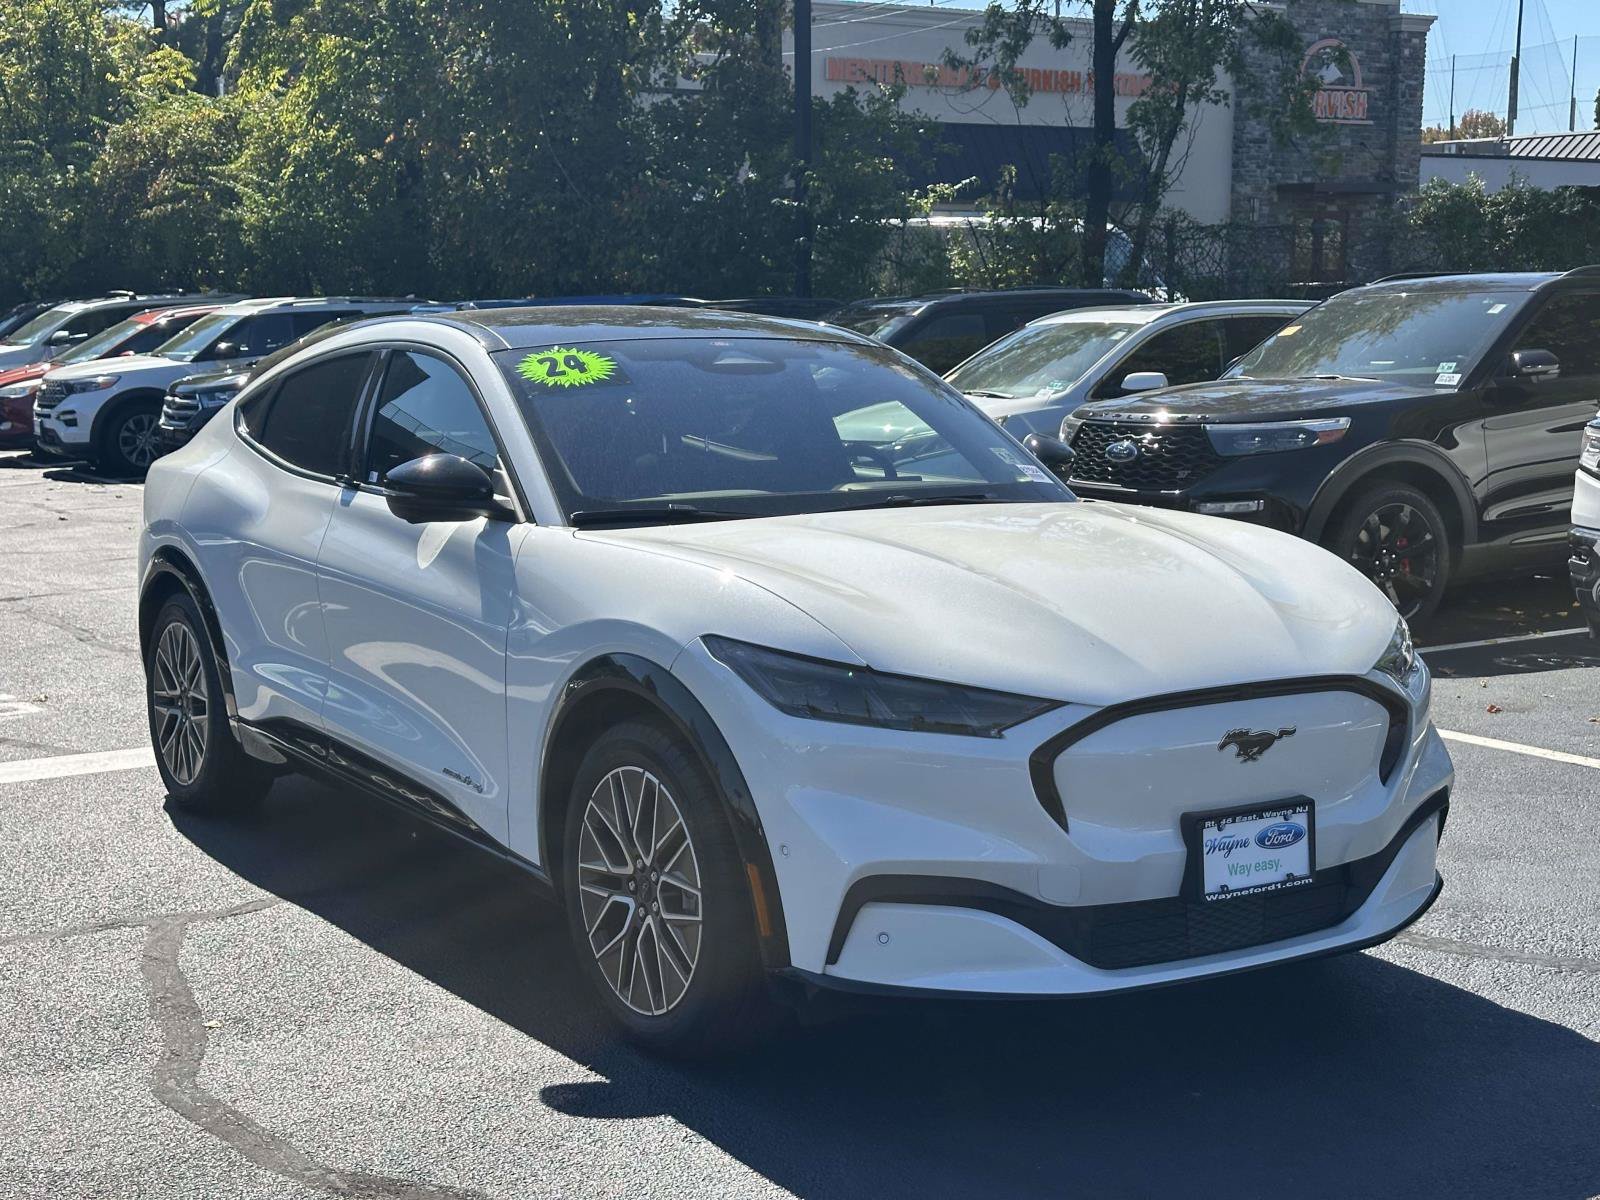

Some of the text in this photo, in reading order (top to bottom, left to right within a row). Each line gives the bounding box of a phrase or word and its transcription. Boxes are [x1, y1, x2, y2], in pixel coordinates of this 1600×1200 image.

[1297, 90, 1368, 119] RVISH
[537, 355, 588, 377] 24
[1263, 808, 1293, 819] Wayne
[1296, 805, 1309, 814] NJ
[1205, 826, 1295, 858] Wayne Ford
[1228, 858, 1283, 877] Way easy.
[1205, 878, 1313, 901] Wayneford1.com
